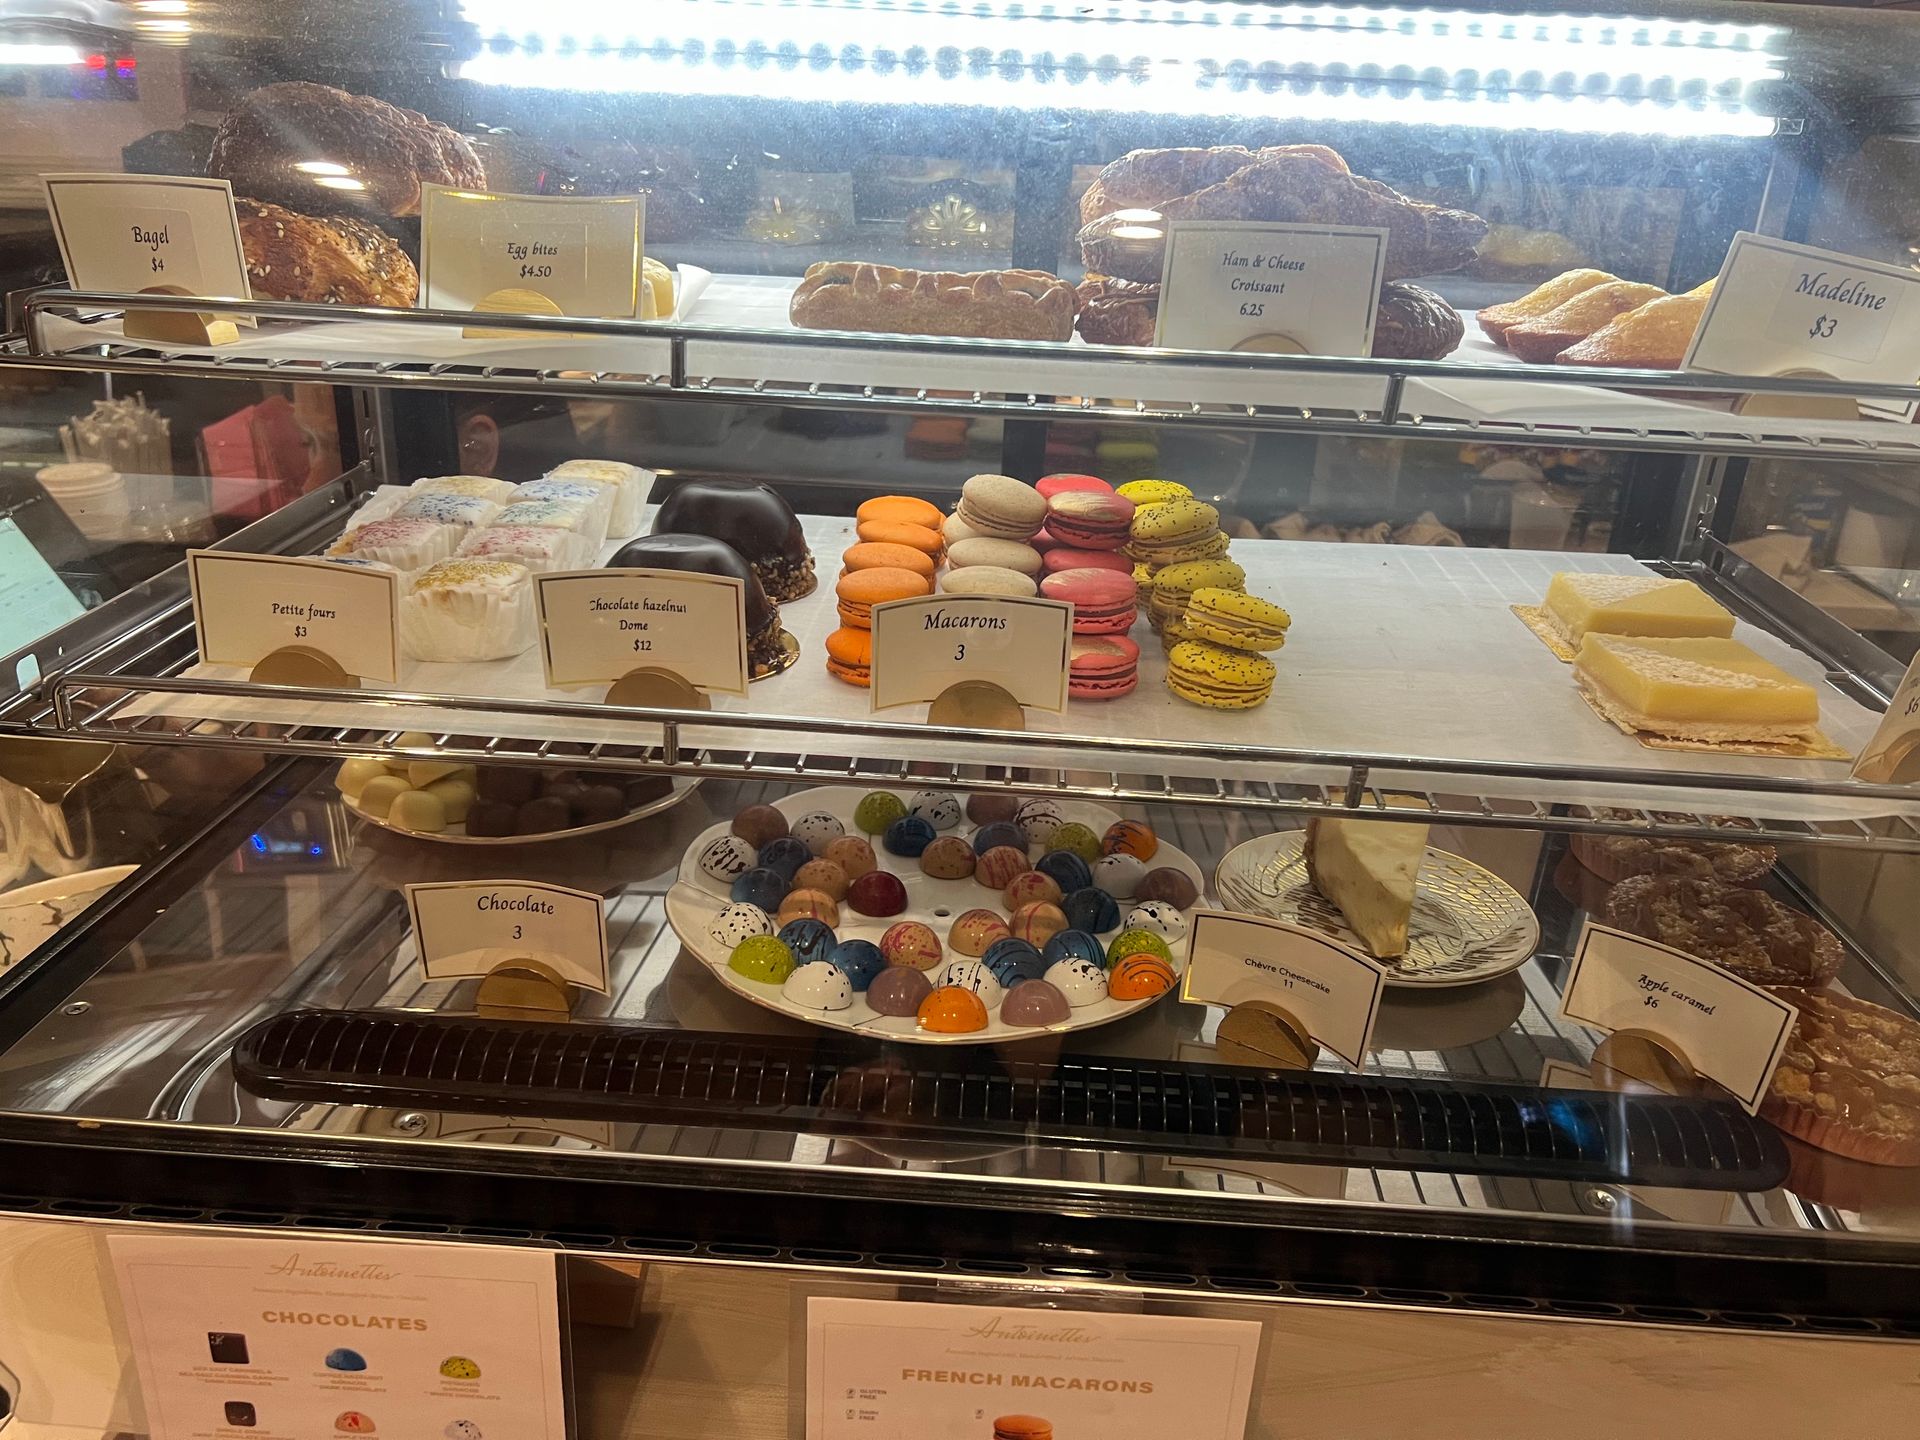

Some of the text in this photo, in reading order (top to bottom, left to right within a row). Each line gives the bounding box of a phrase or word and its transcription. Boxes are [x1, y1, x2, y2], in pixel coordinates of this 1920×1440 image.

[131, 224, 169, 252] Bagel
[507, 241, 558, 260] Egg bites
[151, 256, 165, 273] $4
[1222, 250, 1305, 271] Ham & Cheese
[519, 264, 552, 279] $4.50
[1231, 278, 1285, 293] Croissant
[1795, 272, 1886, 310] Madeline
[1239, 302, 1265, 316] 6.25
[1809, 313, 1838, 339] $3
[271, 603, 336, 621] Petite fours
[923, 608, 1008, 630] Macarons
[294, 625, 307, 638] $3
[618, 619, 649, 631] Dome
[633, 639, 652, 652] $12
[954, 644, 966, 661] 3
[477, 893, 555, 915] Chocolate
[512, 925, 522, 940] 3
[1279, 967, 1331, 994] Cheesecake
[1283, 979, 1294, 989] 11
[1638, 973, 1717, 1015] Apple caramel
[1643, 995, 1660, 1009] $6
[261, 1310, 429, 1332] CHOCOLATES
[901, 1368, 1154, 1394] FRENCH MACARONS
